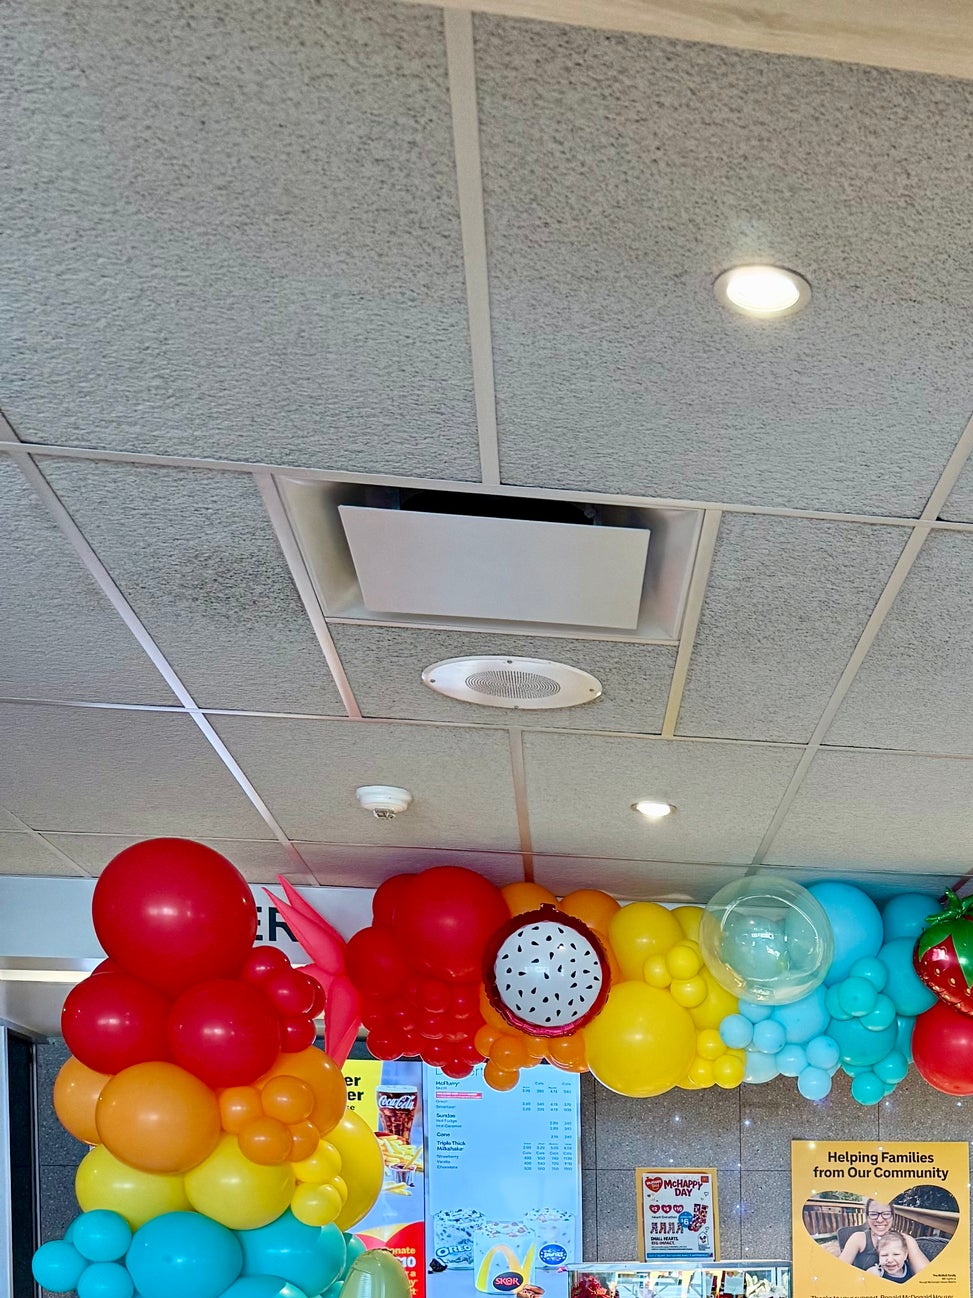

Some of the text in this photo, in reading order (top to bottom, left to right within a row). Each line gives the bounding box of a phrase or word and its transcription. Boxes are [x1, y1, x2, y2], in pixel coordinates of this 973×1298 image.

[828, 1152, 934, 1165] Helping Families
[814, 1167, 949, 1181] from Our Community
[664, 1179, 703, 1190] McHAPPY
[675, 1188, 693, 1197] DAY
[495, 1277, 520, 1286] SKOR
